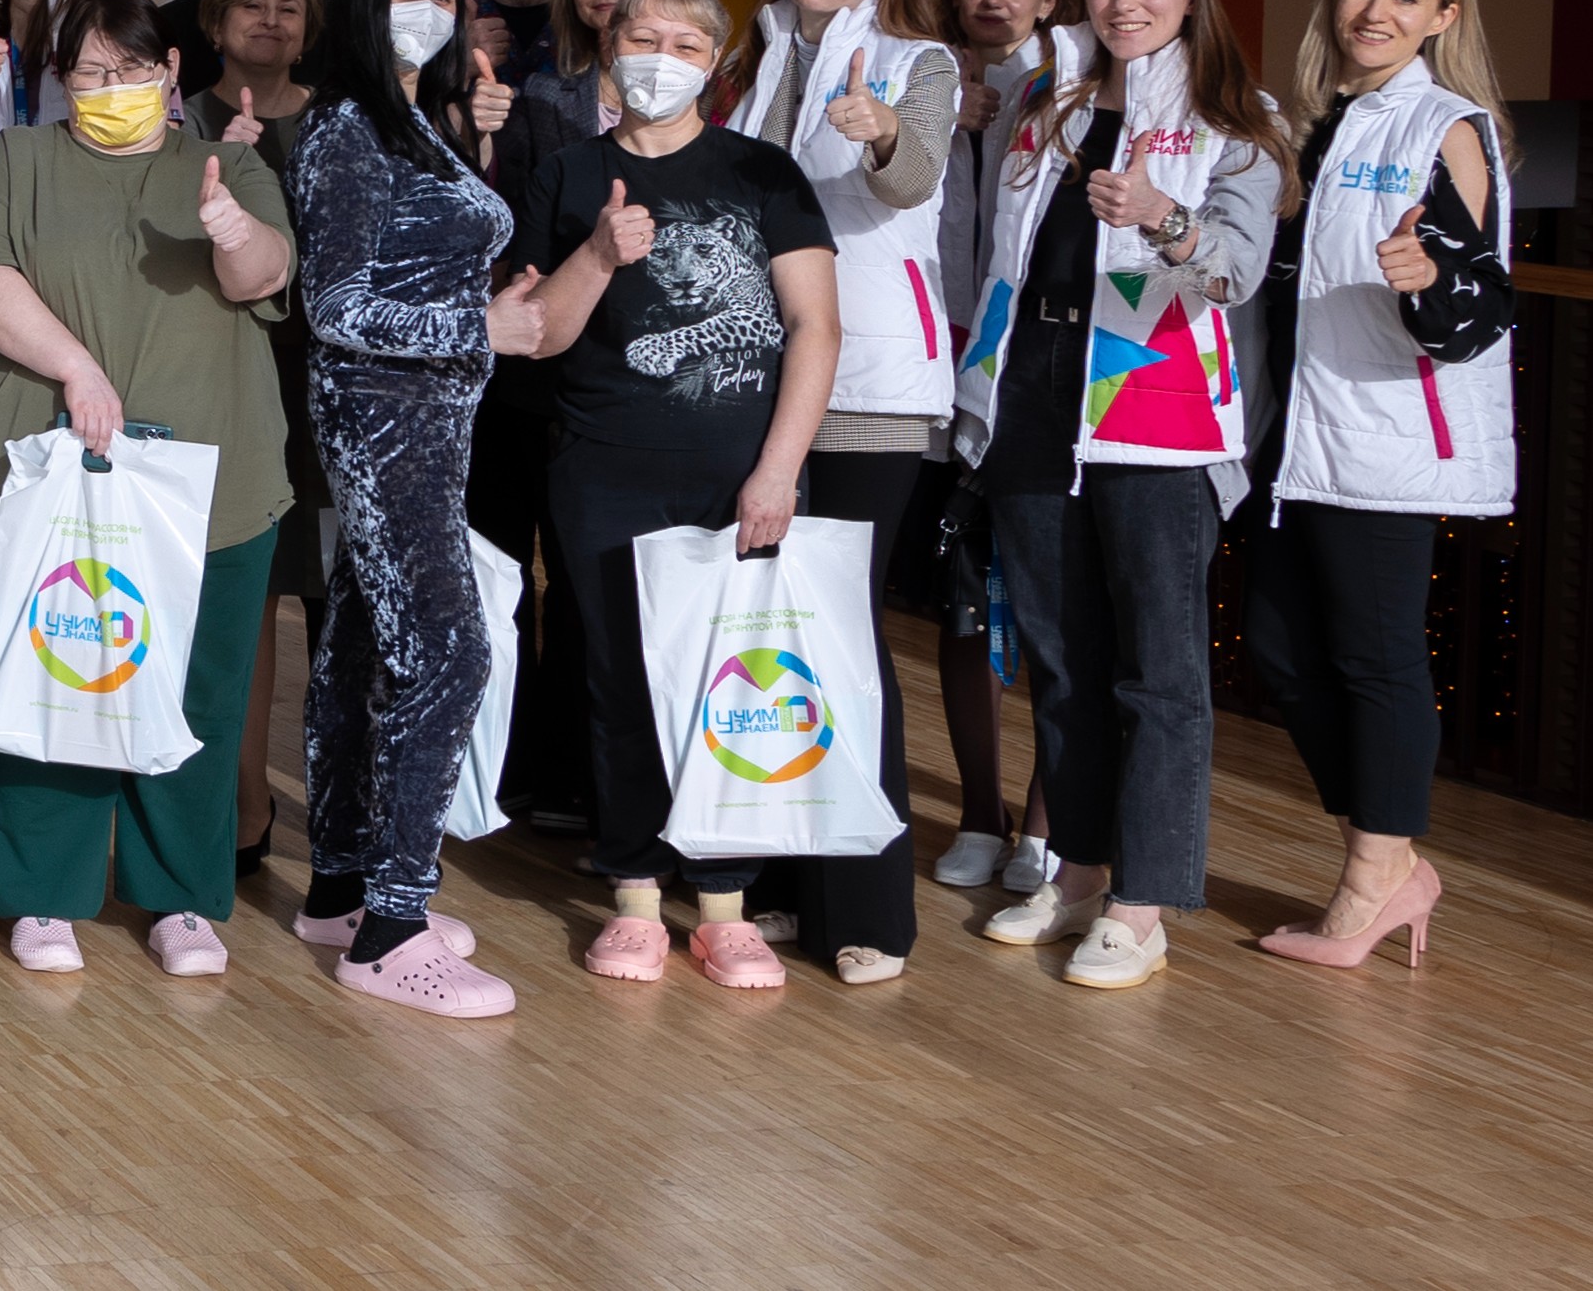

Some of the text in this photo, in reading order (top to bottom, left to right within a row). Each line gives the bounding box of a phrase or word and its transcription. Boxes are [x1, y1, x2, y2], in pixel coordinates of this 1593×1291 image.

[711, 360, 765, 393] today
[45, 610, 102, 637] УЧИМ
[60, 627, 103, 642] ЗНАЕМ
[716, 708, 777, 734] УЧИМ
[734, 719, 779, 734] ЗНАЕМ
